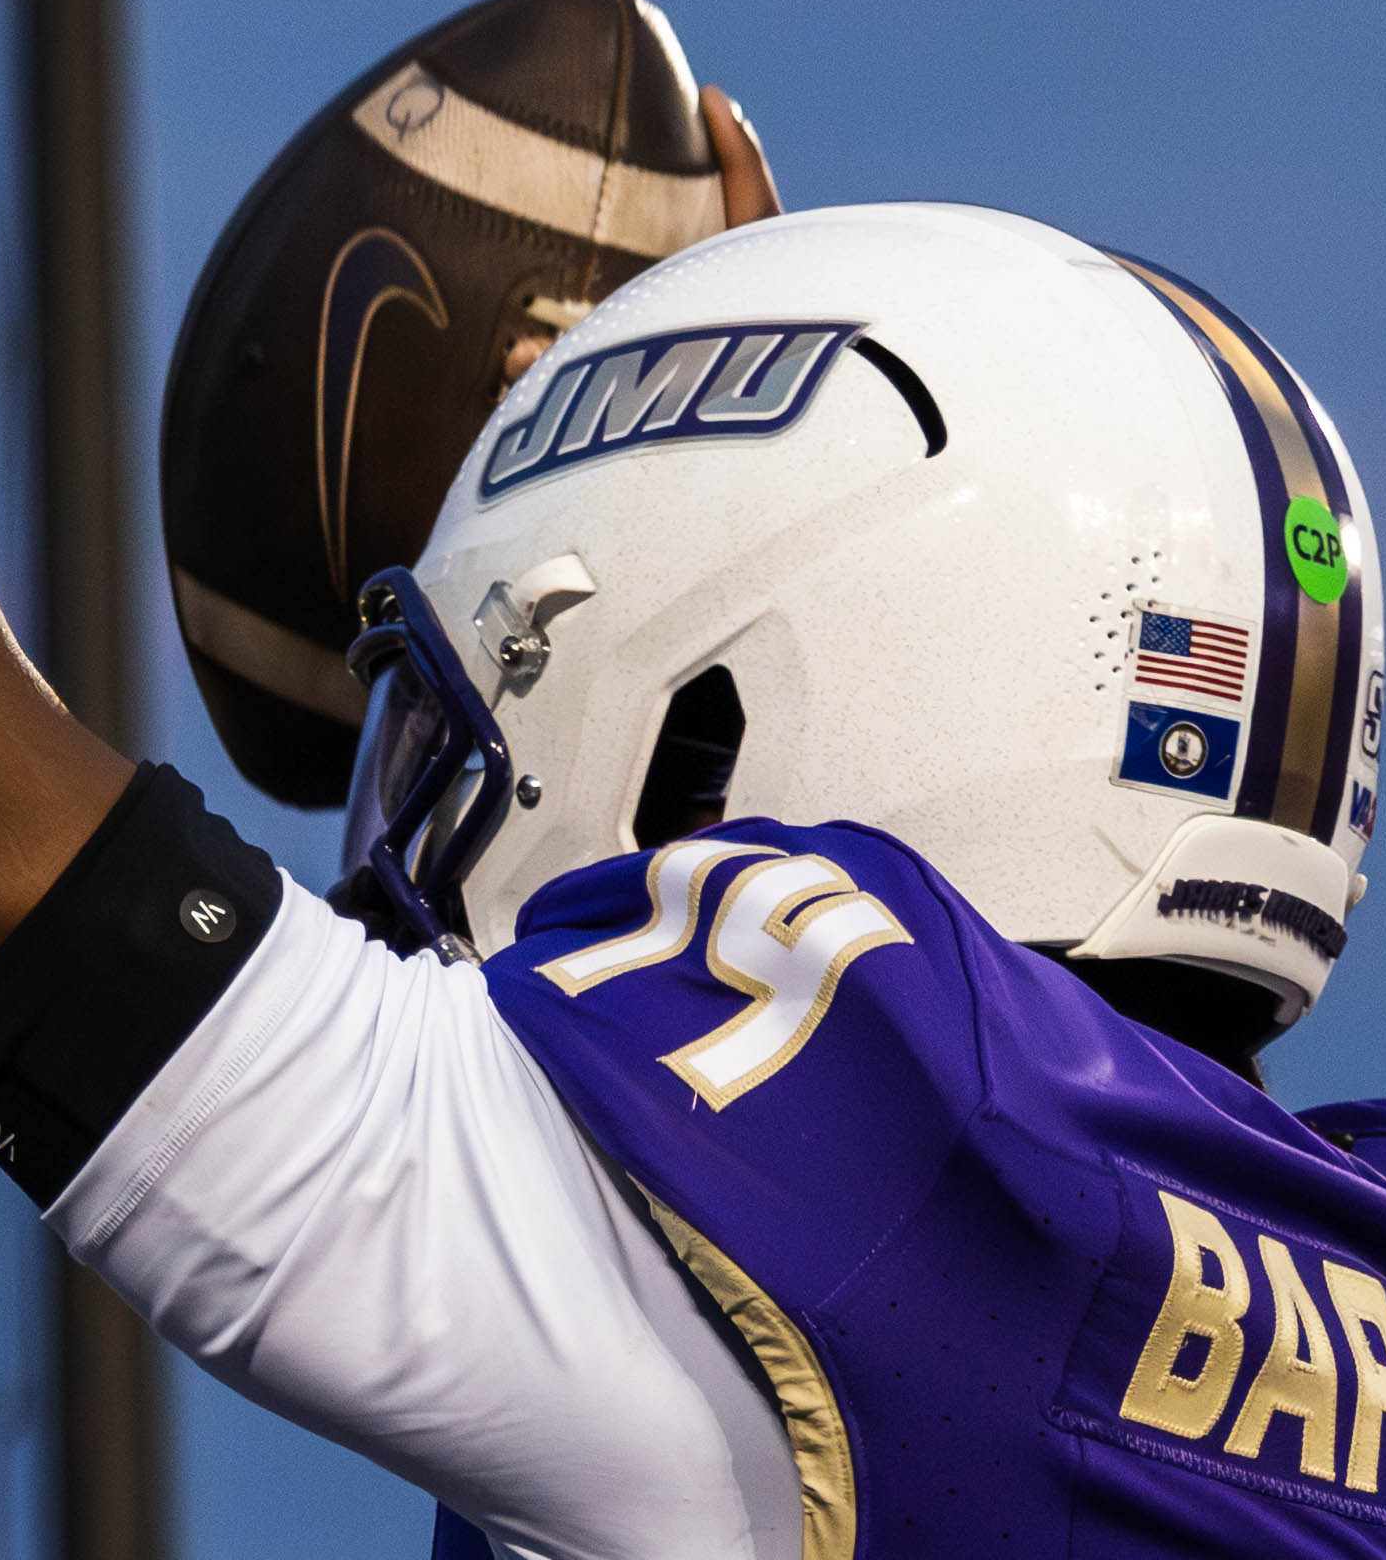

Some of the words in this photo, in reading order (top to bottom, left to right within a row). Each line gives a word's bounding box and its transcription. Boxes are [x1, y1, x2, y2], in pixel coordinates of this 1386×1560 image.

[487, 330, 839, 486] JMU
[1293, 523, 1341, 569] C2P
[532, 838, 916, 1114] 14
